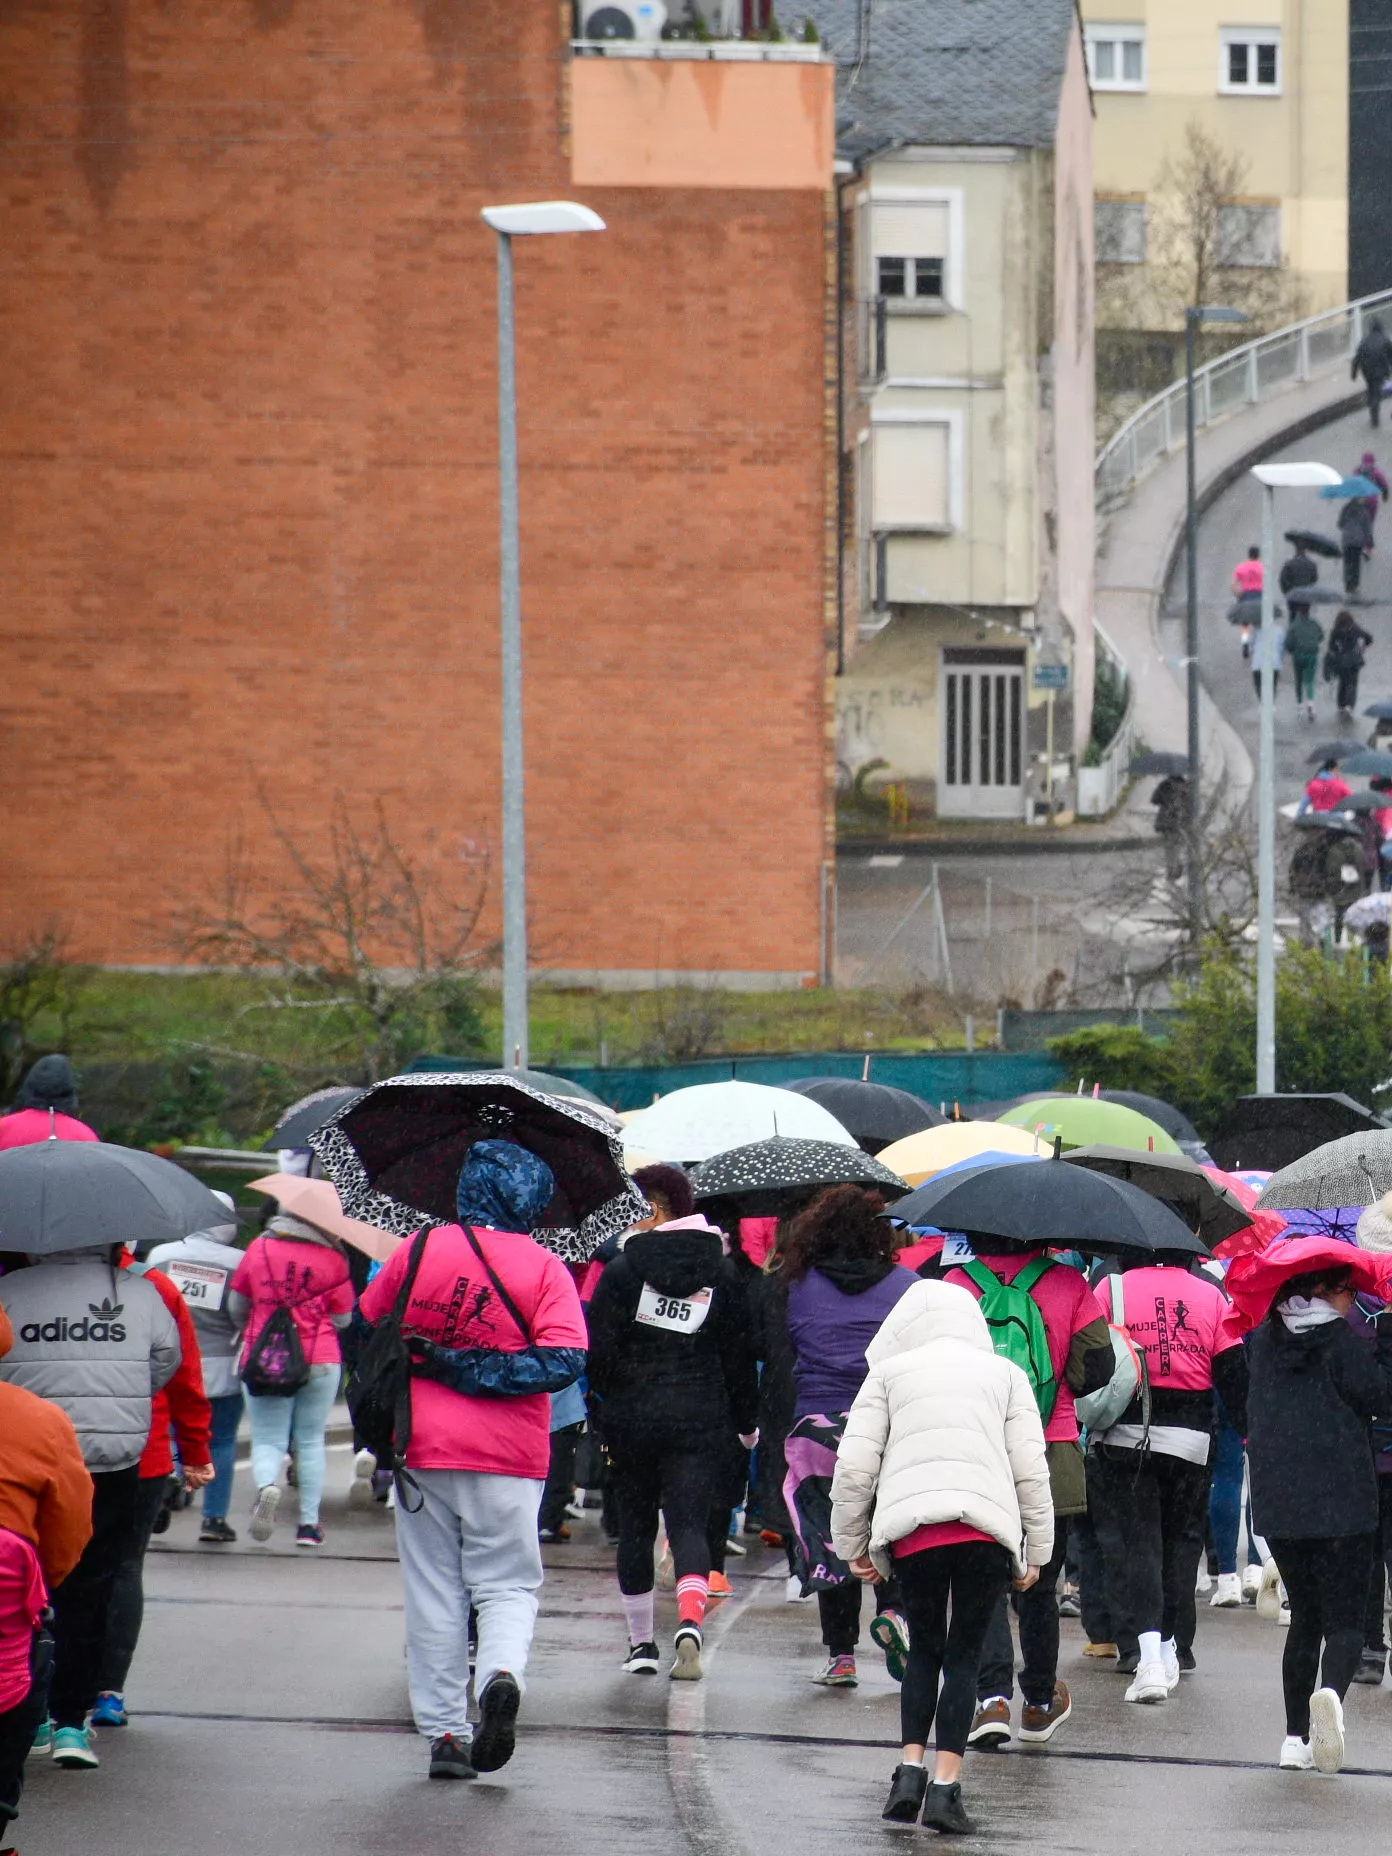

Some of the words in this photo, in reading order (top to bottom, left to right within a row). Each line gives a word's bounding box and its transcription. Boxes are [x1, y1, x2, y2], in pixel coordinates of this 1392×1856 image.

[181, 1279, 208, 1298] 251
[654, 1297, 692, 1321] 365
[20, 1316, 127, 1343] adidas
